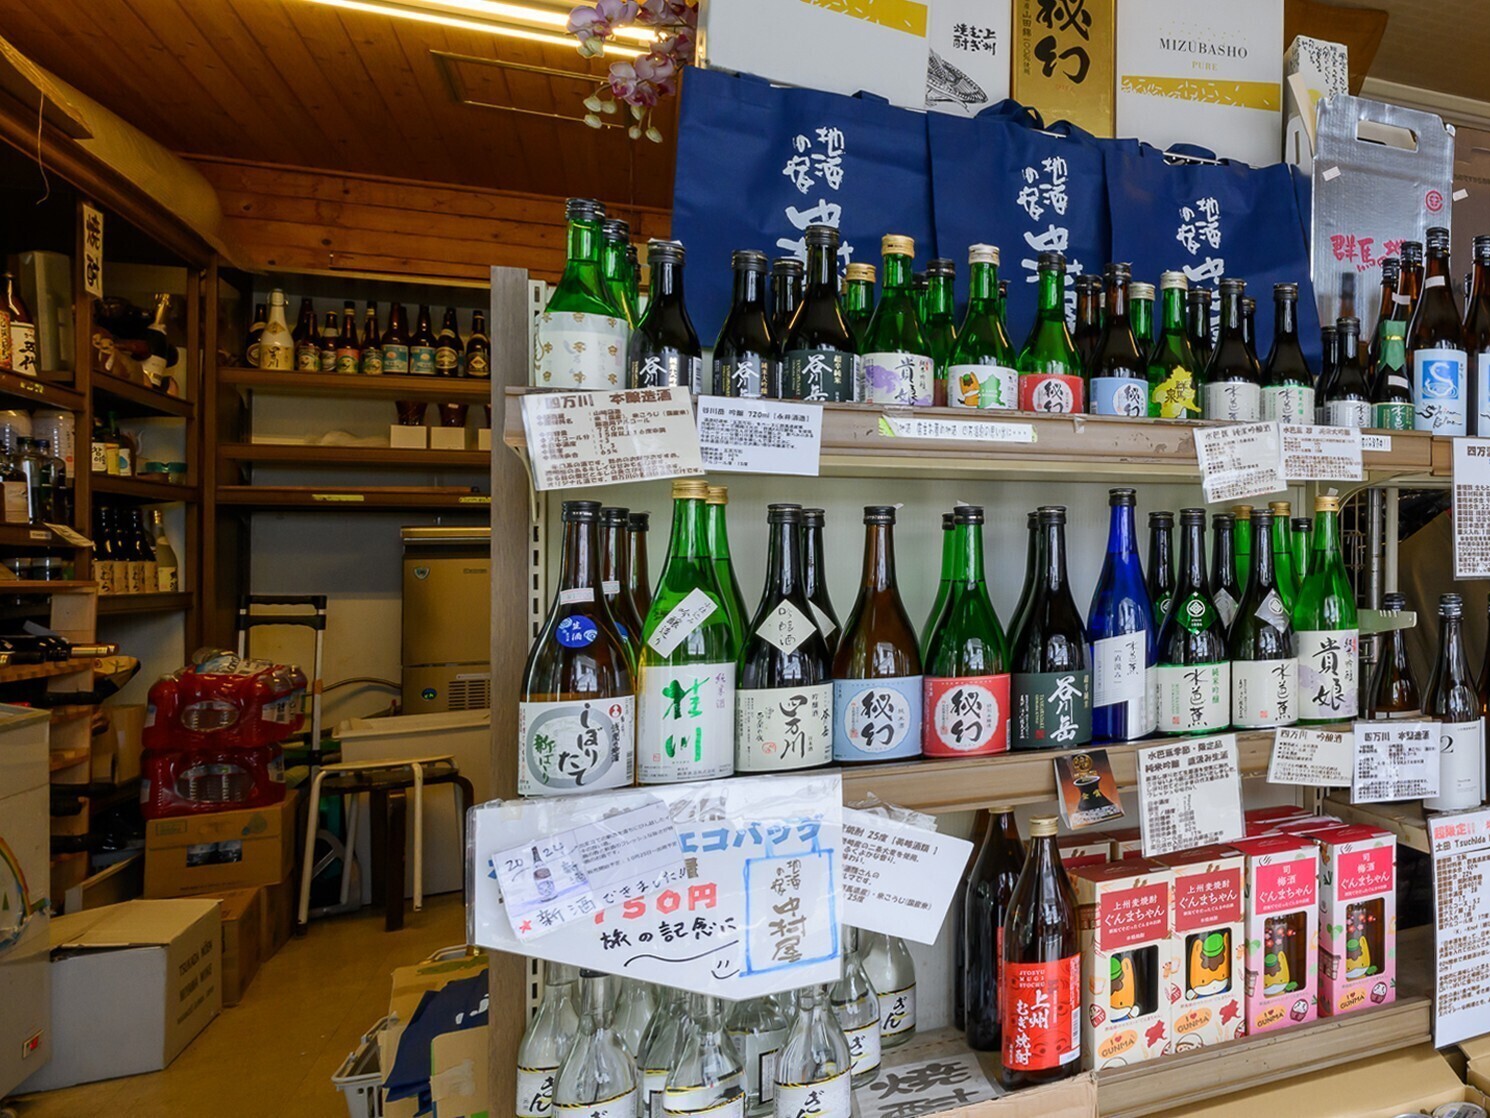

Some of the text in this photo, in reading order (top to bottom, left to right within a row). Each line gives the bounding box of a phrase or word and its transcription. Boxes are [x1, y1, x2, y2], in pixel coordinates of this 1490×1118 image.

[953, 24, 968, 51] 焼酎
[970, 26, 983, 51] むぎ
[983, 28, 996, 55] 上州
[1034, 0, 1092, 84] 秘幻
[1159, 36, 1248, 59] MIZUBASHO
[1191, 61, 1218, 71] PURE
[782, 134, 815, 194] の宿
[816, 126, 846, 190] 地酒
[1017, 167, 1045, 221] の宿
[1040, 156, 1068, 215] 地酒
[1176, 207, 1201, 255] の宿
[1196, 197, 1221, 248] 地酒
[545, 389, 672, 409] 四万川 本醸造酒
[702, 407, 724, 415] 谷川岳
[1211, 667, 1219, 704] 純米吟醸
[1312, 636, 1346, 711] 貴娘
[1048, 675, 1083, 742] 谷川岳
[1183, 668, 1209, 728] 水芭蕉
[662, 676, 711, 762] 桂川
[779, 694, 808, 759] 四万川
[860, 690, 895, 747] 秘幻
[950, 688, 983, 743] 秘幻
[1280, 729, 1343, 744] 四万川 吟醸酒
[1364, 731, 1391, 742] 四万川
[1145, 760, 1180, 773] 純米吟醸
[867, 830, 888, 842] 25度
[1435, 841, 1452, 853] 土田
[1454, 835, 1486, 848] Tsuchida
[505, 857, 524, 872] 20
[1283, 864, 1291, 874] 司
[1357, 861, 1376, 873] 梅酒
[1362, 852, 1371, 861] 司
[770, 866, 787, 897] の宿
[785, 859, 802, 890] 地酒
[1186, 878, 1230, 895] 上州麦焼酎
[1277, 874, 1296, 887] 梅酒
[1340, 871, 1391, 890] ぐんまちゃん
[1112, 894, 1158, 911] 上州麦焼酎
[1178, 889, 1237, 910] ぐんまちゃん
[1258, 884, 1313, 903] ぐんまちゃん
[1104, 905, 1165, 926] ぐんまちゃん
[600, 916, 737, 950] 旅の記念に
[768, 897, 806, 963] 中村屋
[883, 996, 907, 1030] ぎん
[1029, 988, 1051, 1029] 上州
[1340, 993, 1366, 1009] GUNMA
[1177, 1015, 1209, 1034] GUNMA
[1257, 1011, 1285, 1028] GUNMA
[1015, 999, 1032, 1066] むぎ焼酎
[1101, 1039, 1135, 1059] GUNMA
